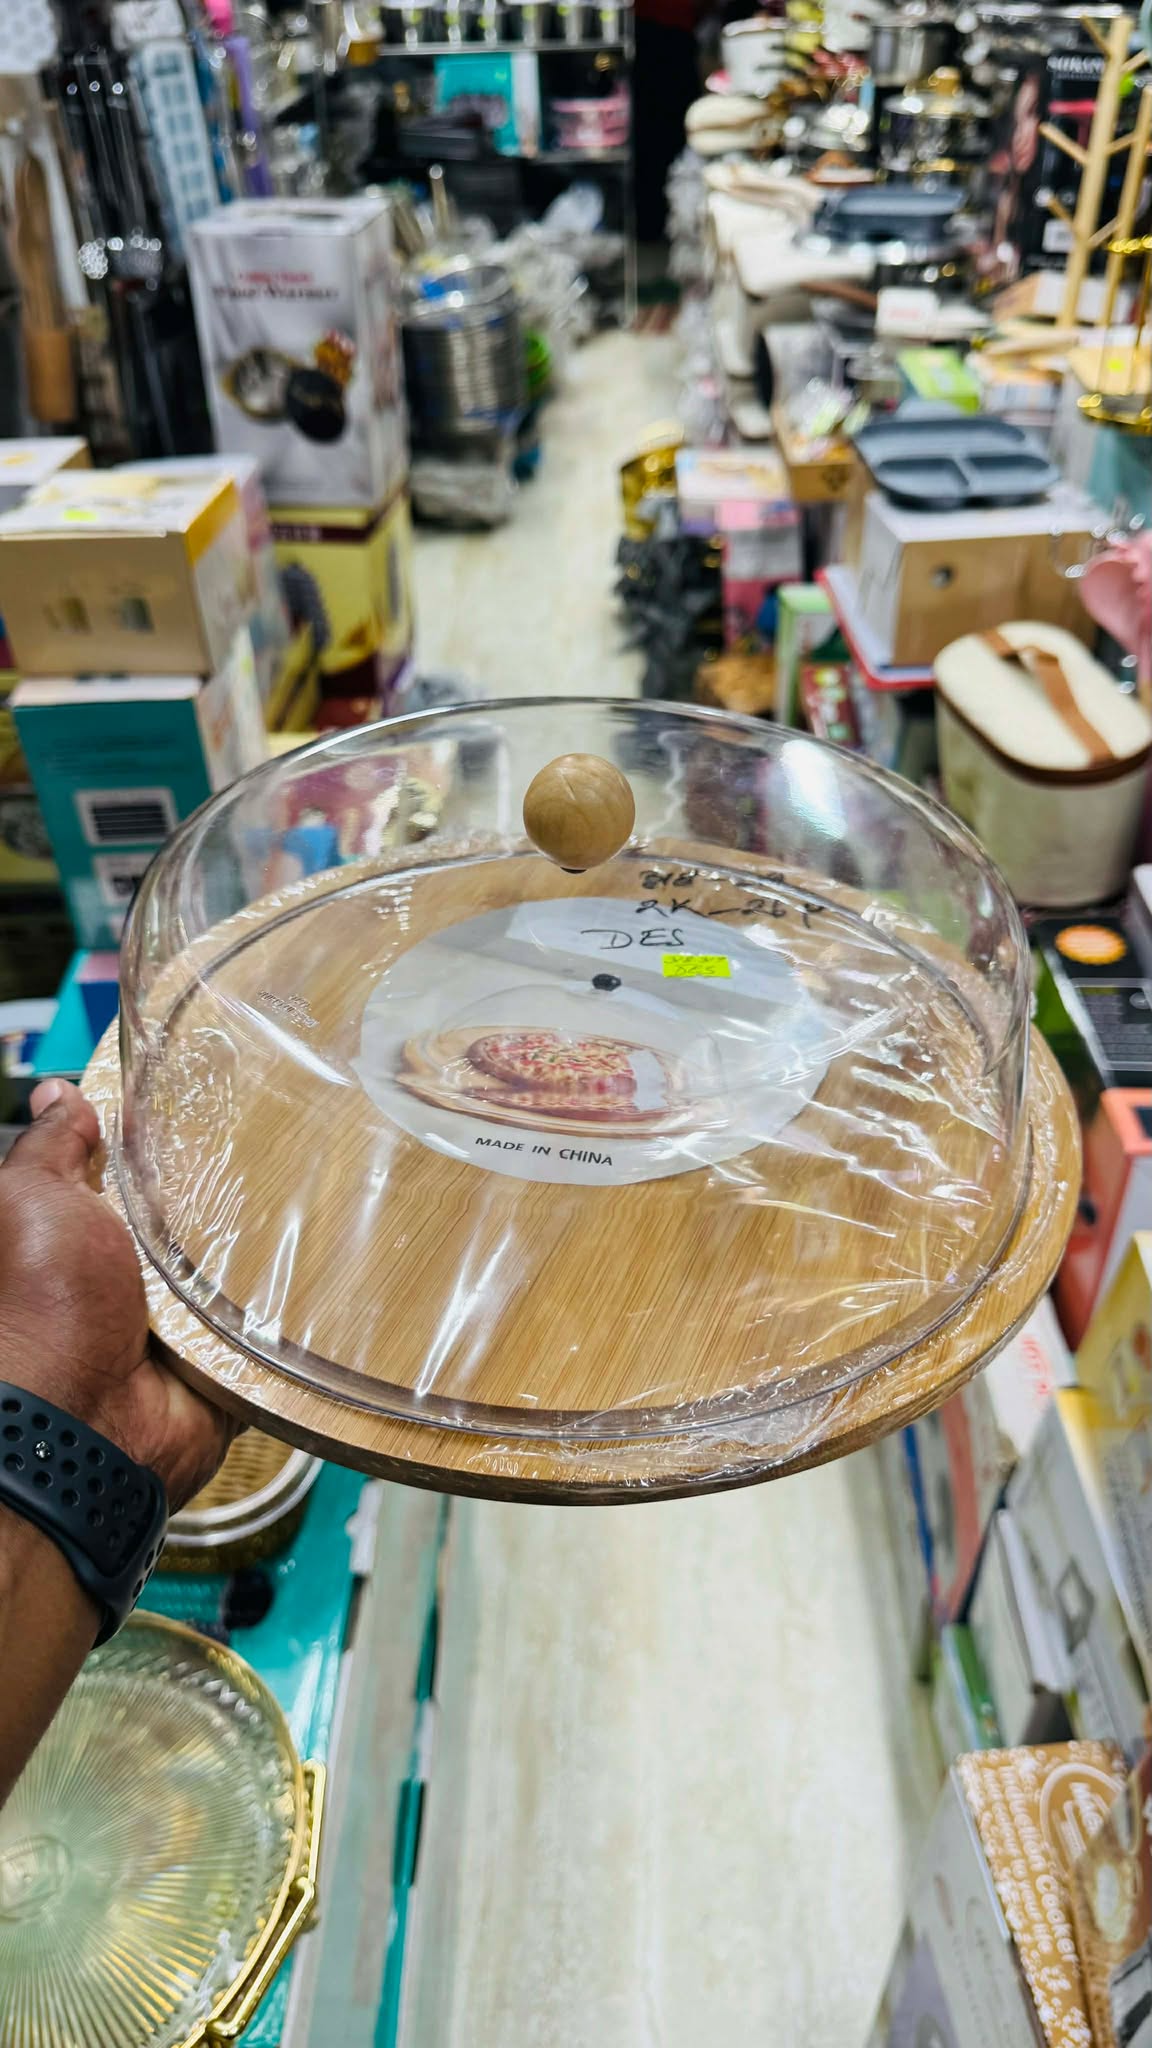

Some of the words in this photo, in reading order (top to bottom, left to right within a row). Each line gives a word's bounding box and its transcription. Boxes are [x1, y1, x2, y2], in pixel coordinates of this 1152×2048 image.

[580, 928, 685, 950] DES
[475, 1137, 525, 1151] MADE
[531, 1145, 552, 1156] IN
[559, 1148, 613, 1166] CHINA
[998, 1765, 1046, 1872] Induction
[1035, 1873, 1080, 1962] Cooker
[1032, 1924, 1053, 1953] life
